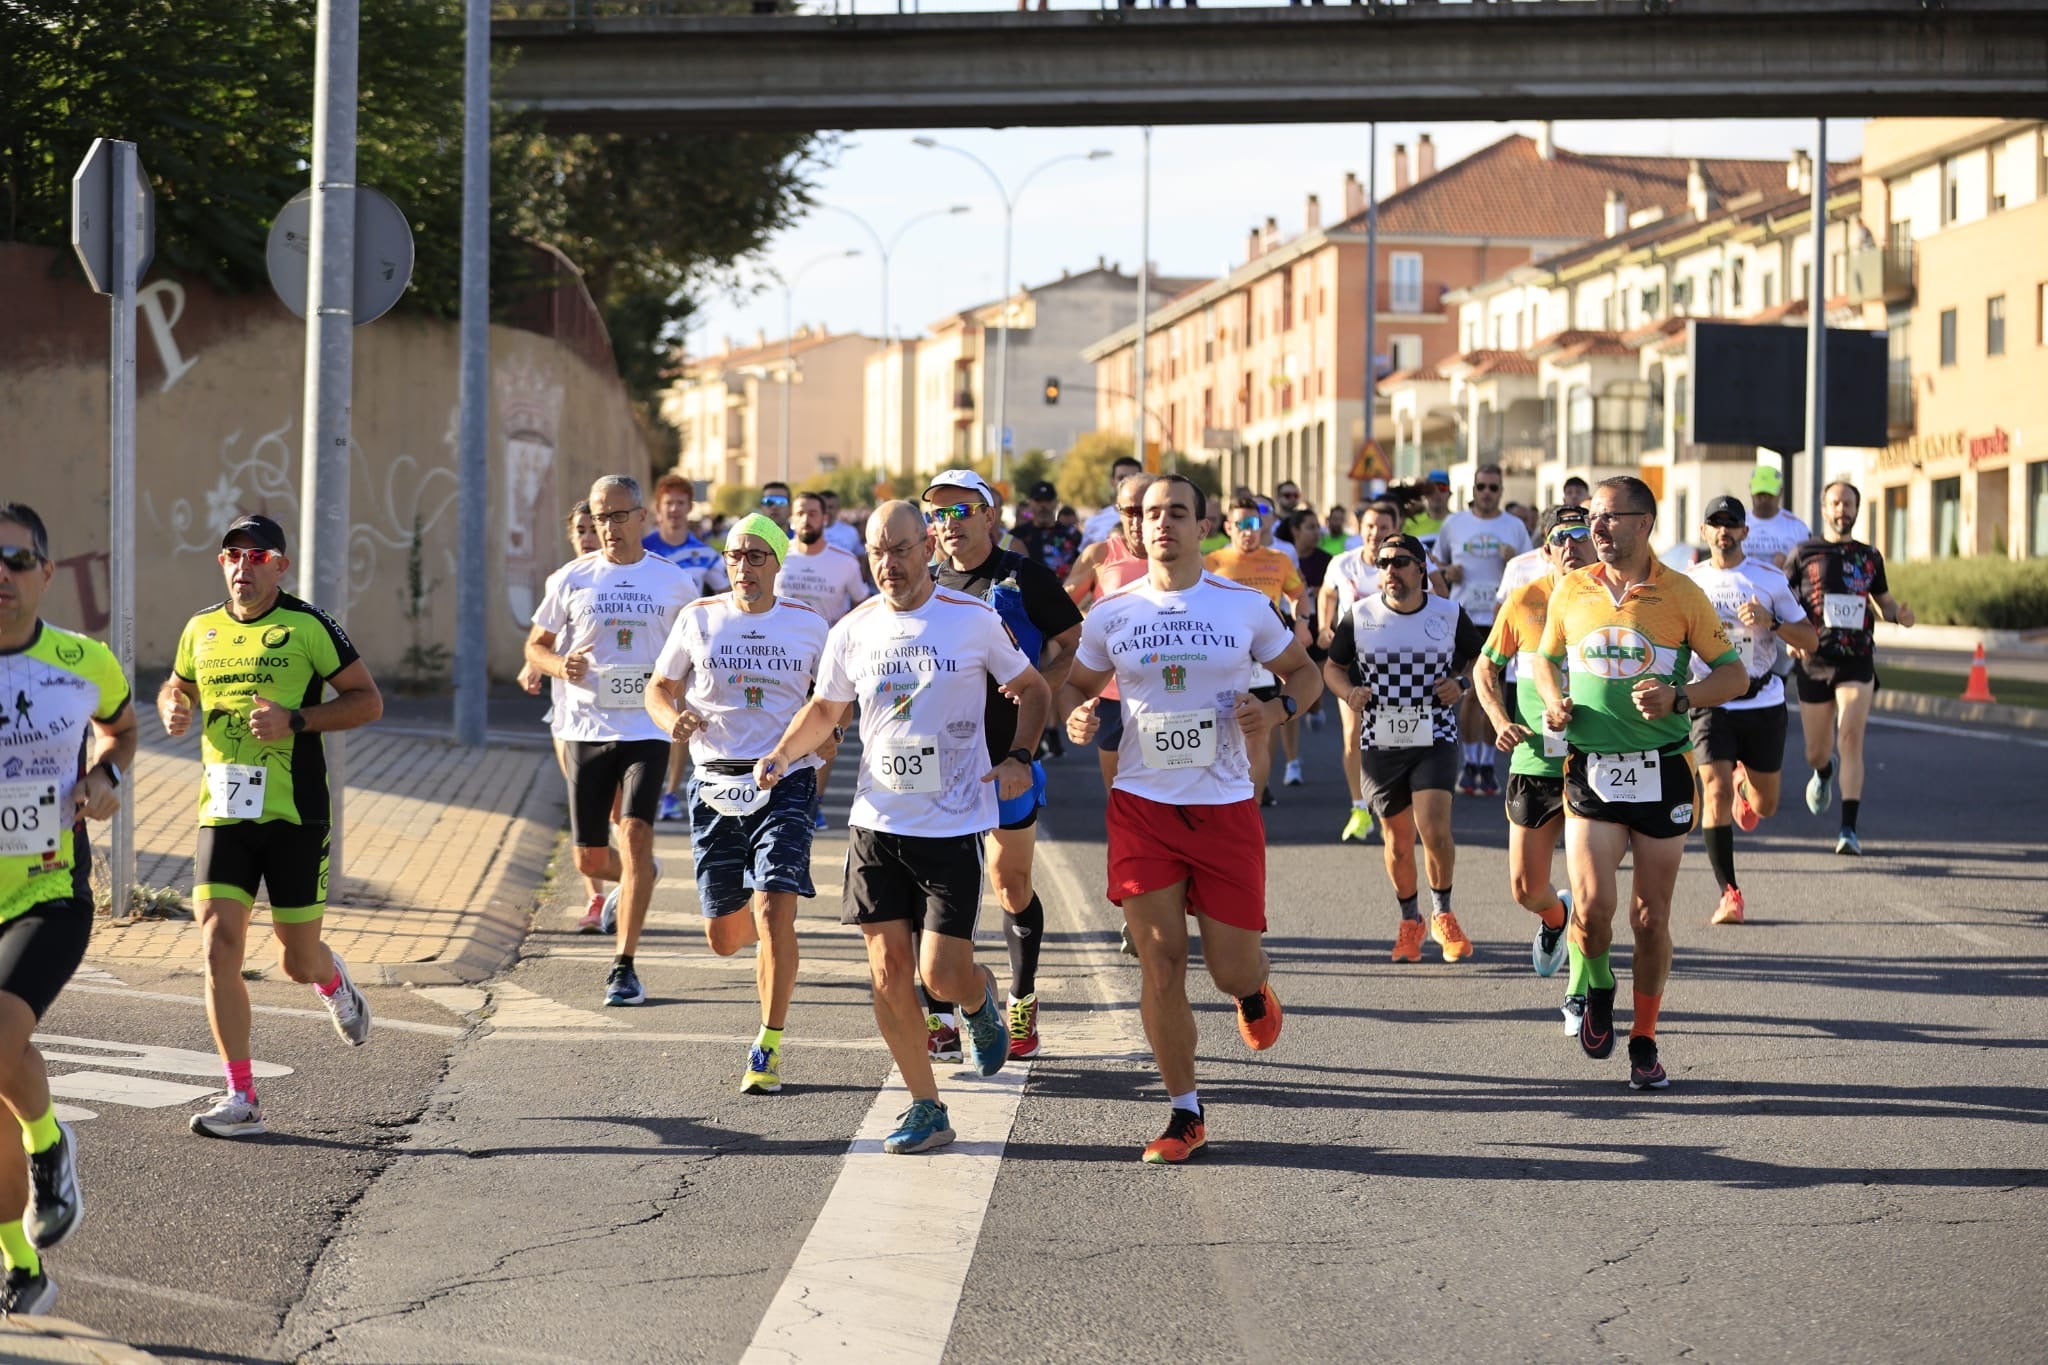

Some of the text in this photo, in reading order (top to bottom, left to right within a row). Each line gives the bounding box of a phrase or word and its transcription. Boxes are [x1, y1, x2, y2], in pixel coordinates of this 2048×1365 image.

[610, 592, 652, 602] CARRERA
[637, 603, 665, 617] CIVIL
[1134, 624, 1146, 635] III
[1151, 620, 1214, 632] CARRERA
[1191, 634, 1239, 649] CIVIL
[720, 645, 787, 657] III CARRERA
[884, 645, 938, 659] CARRERA
[1160, 652, 1207, 662] Iberdrola
[768, 658, 803, 672] CIVIL
[918, 658, 959, 673] CIVIL
[201, 672, 274, 686] CARBAJOSA
[611, 678, 644, 694] 356
[1388, 719, 1420, 734] 197
[1156, 729, 1201, 751] 508
[881, 755, 923, 776] 503
[1610, 768, 1638, 786] 24
